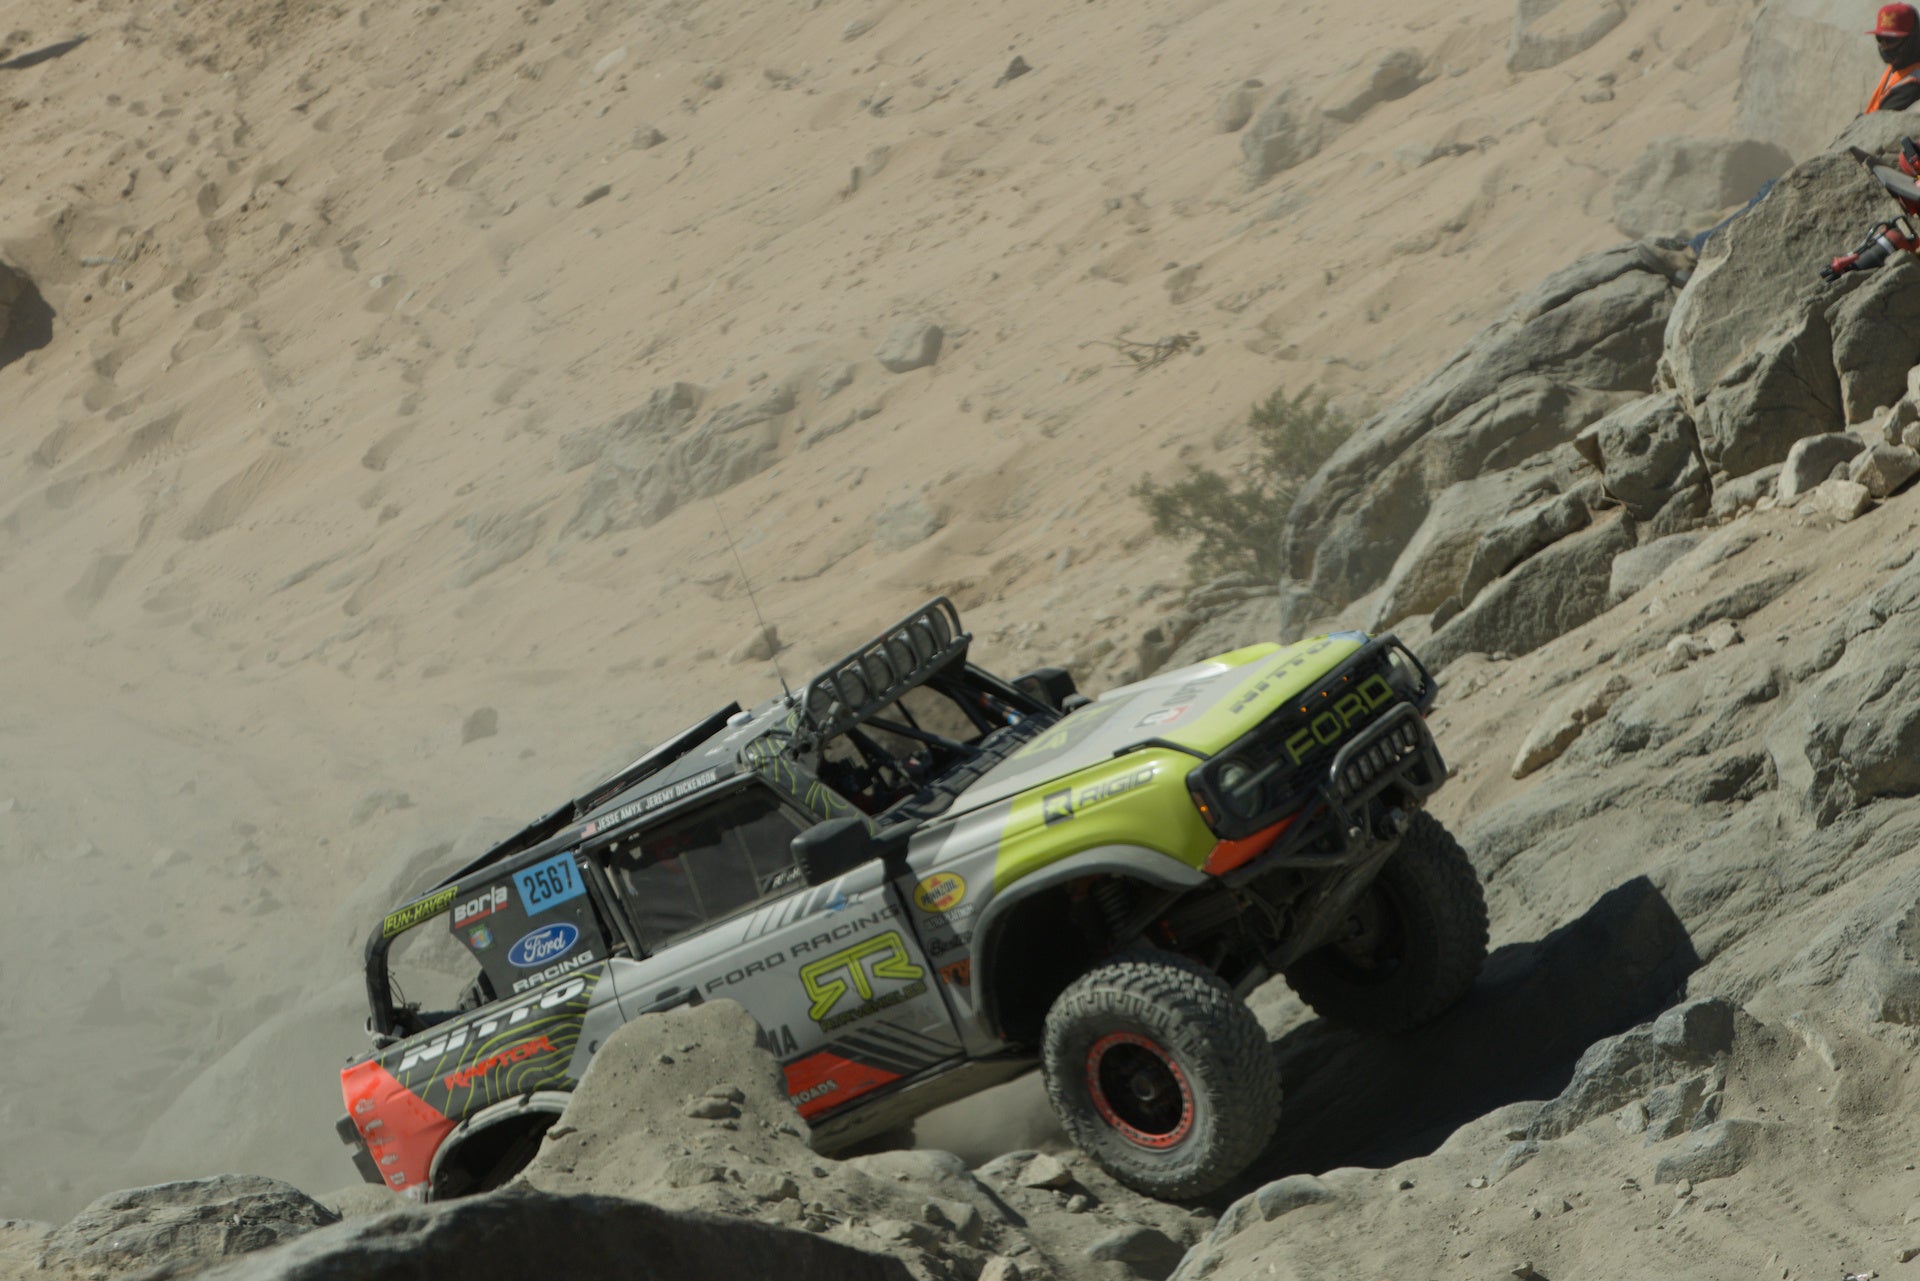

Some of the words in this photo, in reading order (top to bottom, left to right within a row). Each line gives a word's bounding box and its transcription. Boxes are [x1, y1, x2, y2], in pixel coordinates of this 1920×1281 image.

[1285, 673, 1394, 766] FORD
[645, 786, 676, 810] JEREMY
[1078, 767, 1154, 807] RIGID
[523, 859, 573, 905] 2567
[523, 930, 567, 962] Ford
[704, 953, 786, 995] FORD
[790, 903, 900, 957] RACING
[512, 950, 595, 994] RACING
[399, 977, 586, 1073] NITTO
[444, 1035, 558, 1092] RAPTOR
